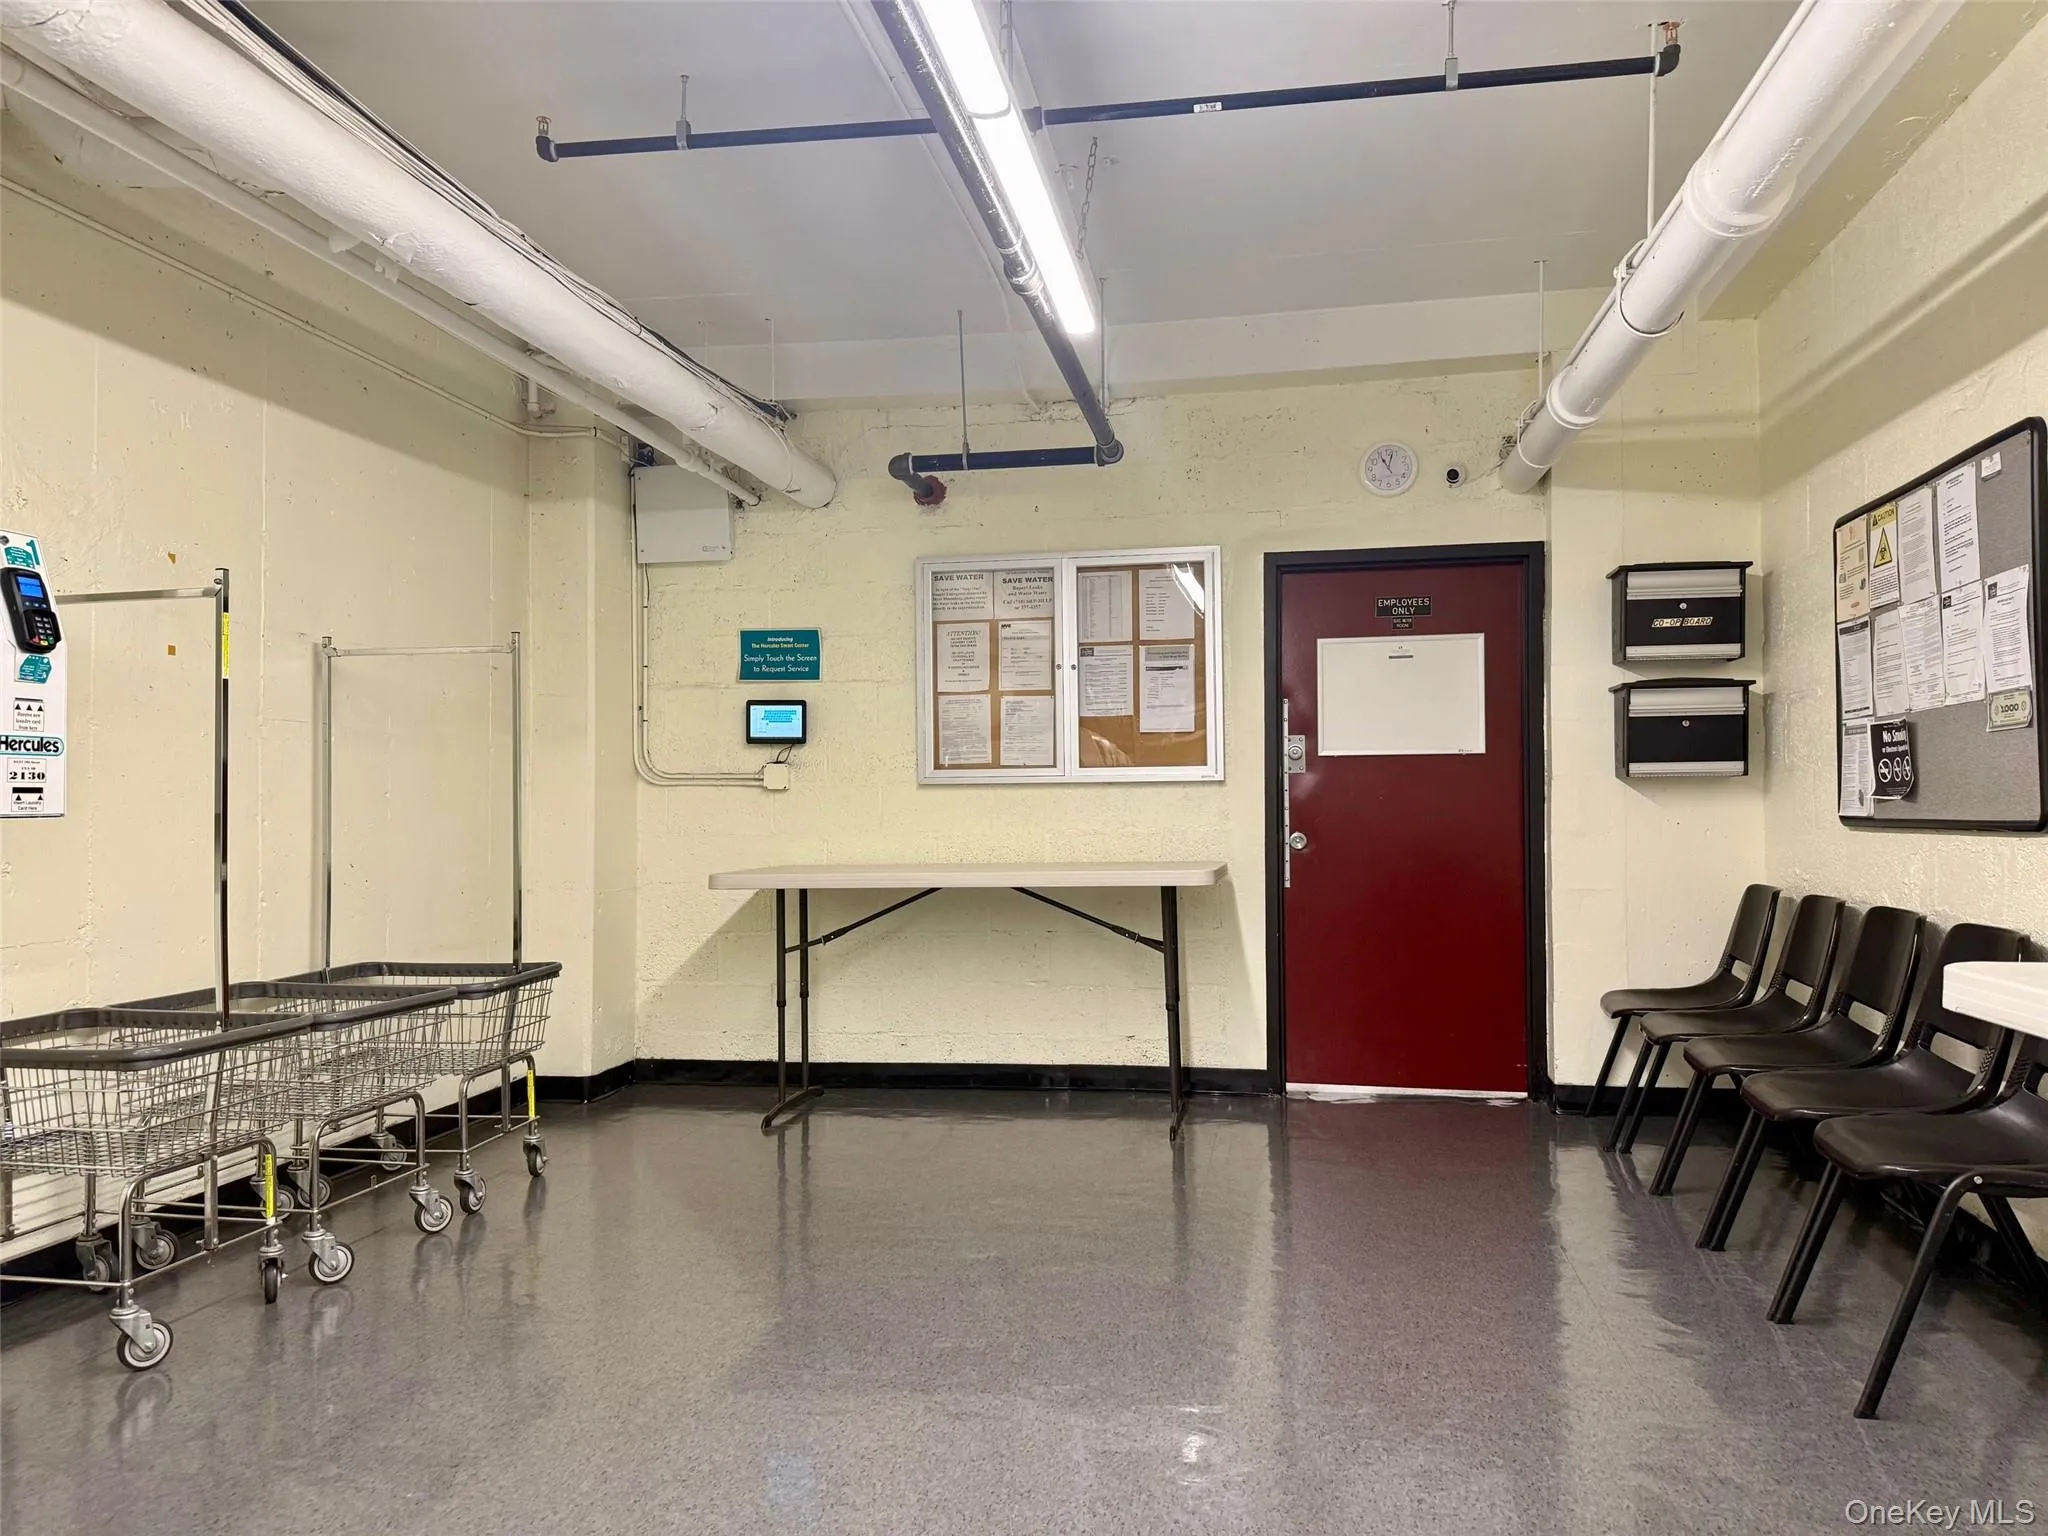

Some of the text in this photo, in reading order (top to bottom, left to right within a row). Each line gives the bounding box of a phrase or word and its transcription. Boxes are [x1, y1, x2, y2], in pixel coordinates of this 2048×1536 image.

[1878, 508, 1894, 521] CAUTION
[1378, 598, 1430, 606] EMPLOYEES
[1684, 617, 1712, 625] BOARD
[744, 654, 764, 662] Simply
[797, 653, 817, 661] Screen
[788, 664, 809, 672] Service
[2000, 703, 2019, 713] 1000
[1882, 730, 1891, 743] No
[0, 736, 59, 752] Hercules
[9, 772, 45, 780] 2130
